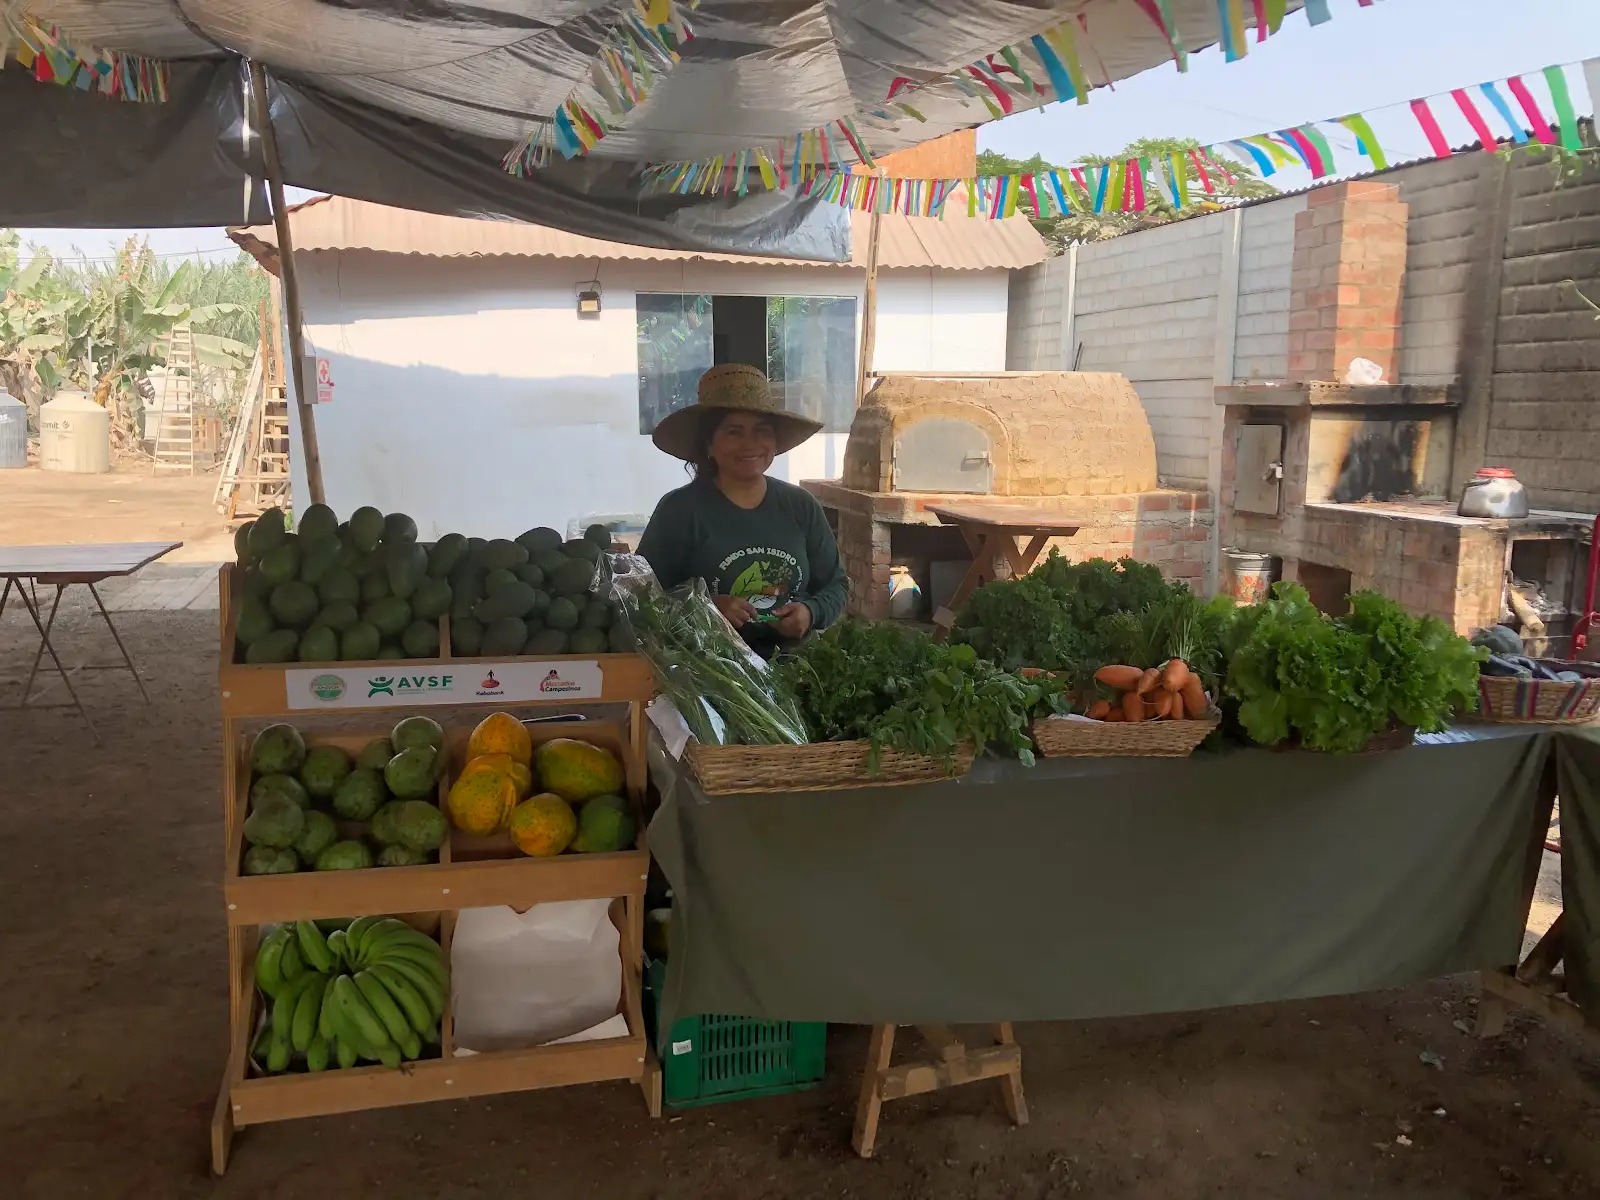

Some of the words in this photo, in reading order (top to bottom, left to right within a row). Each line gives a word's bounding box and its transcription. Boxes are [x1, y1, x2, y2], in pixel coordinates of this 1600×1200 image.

[719, 550, 745, 570] FUNDO
[746, 547, 765, 555] SAN
[767, 547, 797, 566] ISIDRO
[397, 675, 453, 688] AVSF
